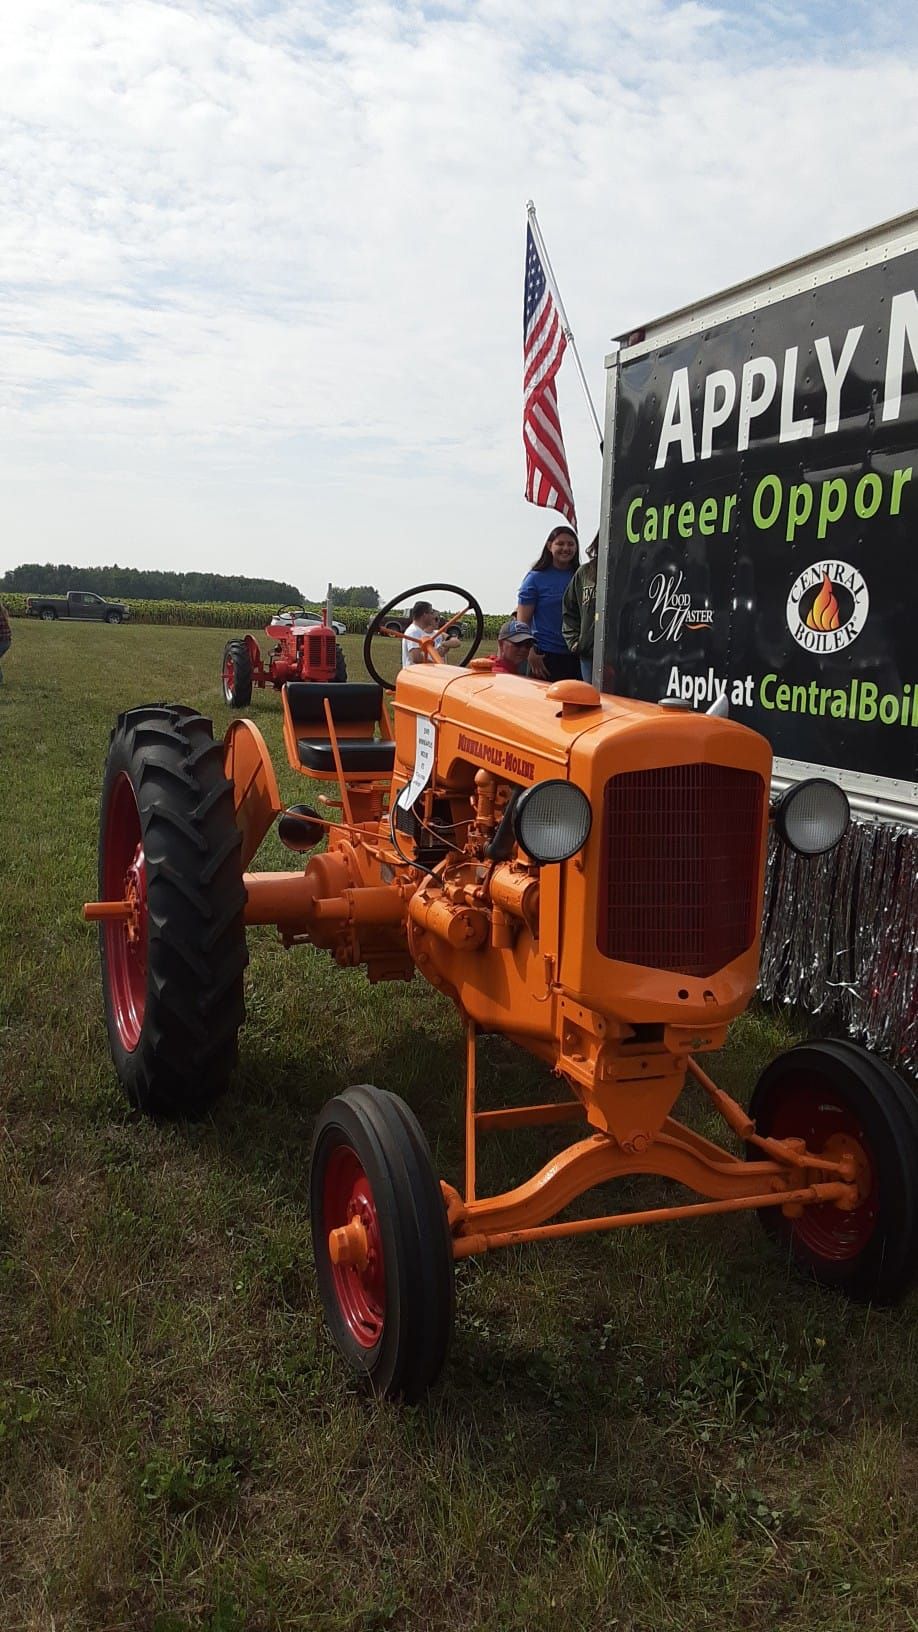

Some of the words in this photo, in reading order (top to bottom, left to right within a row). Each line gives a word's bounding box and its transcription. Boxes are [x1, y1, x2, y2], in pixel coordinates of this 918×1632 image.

[654, 324, 864, 470] APPLY
[626, 493, 737, 544] Career
[751, 466, 913, 542] Oppor
[791, 563, 865, 605] CENTRAL
[795, 621, 859, 652] BOILER
[666, 665, 728, 709] Apply
[730, 675, 755, 707] at
